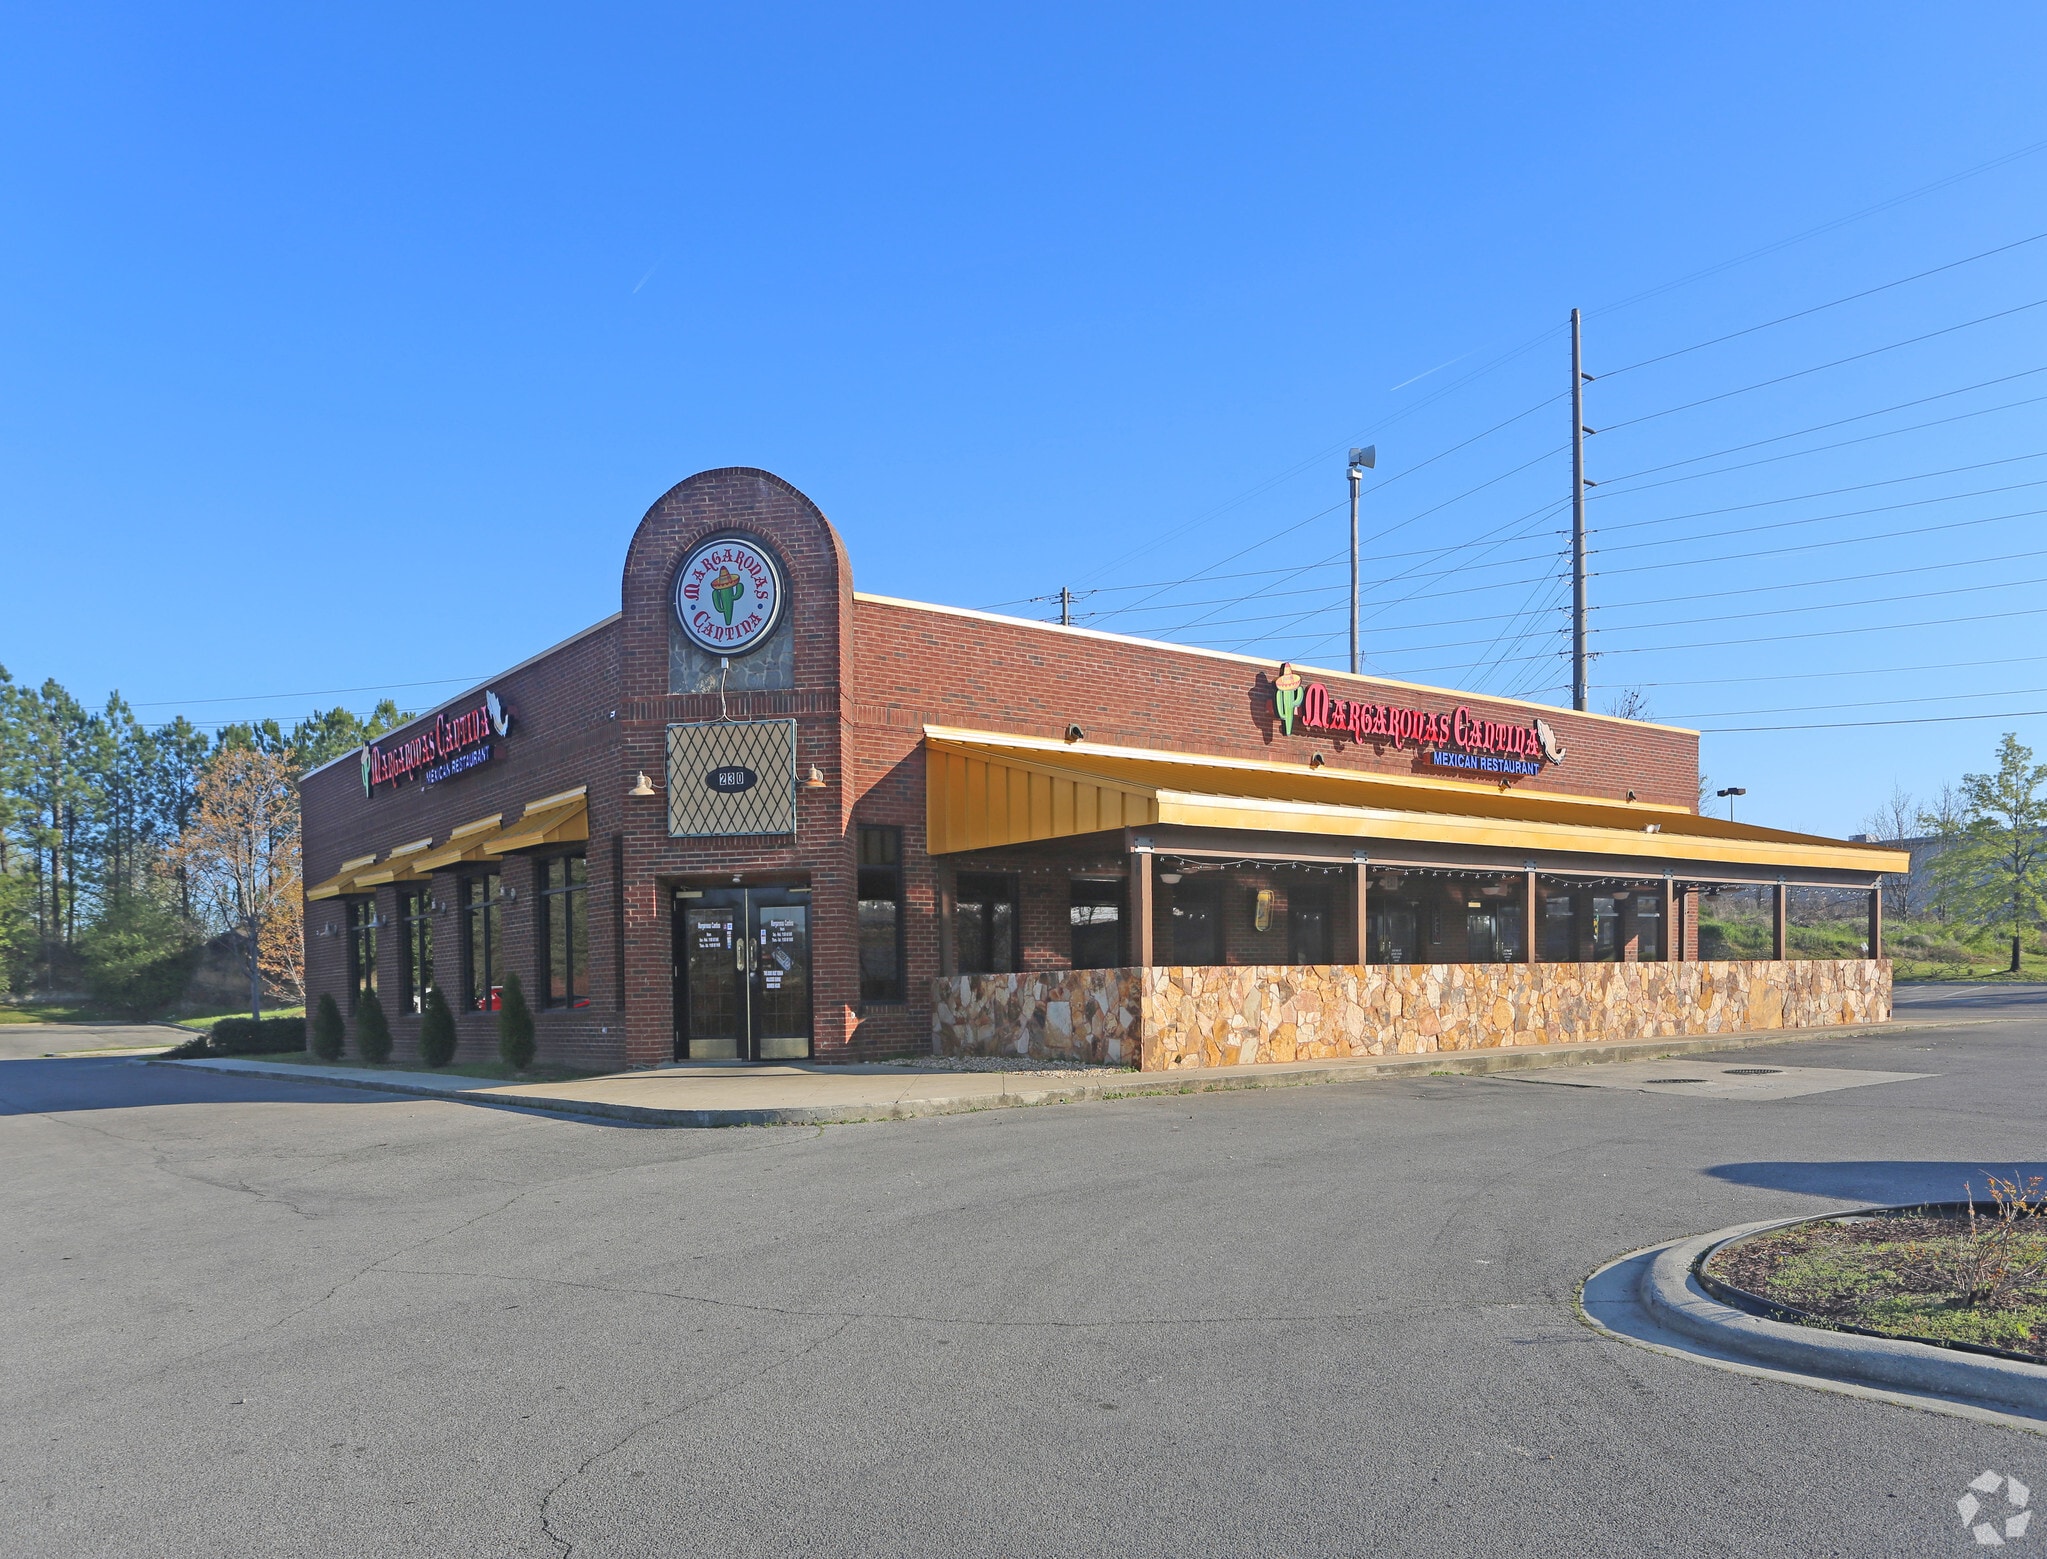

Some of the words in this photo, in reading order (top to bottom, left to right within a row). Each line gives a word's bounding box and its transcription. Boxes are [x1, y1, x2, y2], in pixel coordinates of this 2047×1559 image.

[693, 611, 762, 643] CANTINA
[435, 705, 490, 760] CANTINA
[1453, 705, 1541, 758] CANTINA
[426, 763, 451, 785] MEXICAN
[451, 745, 490, 775] RESTAURANT
[719, 772, 744, 785] 230
[1433, 751, 1478, 770] MEXICAN
[1480, 757, 1540, 776] RESTAURANT
